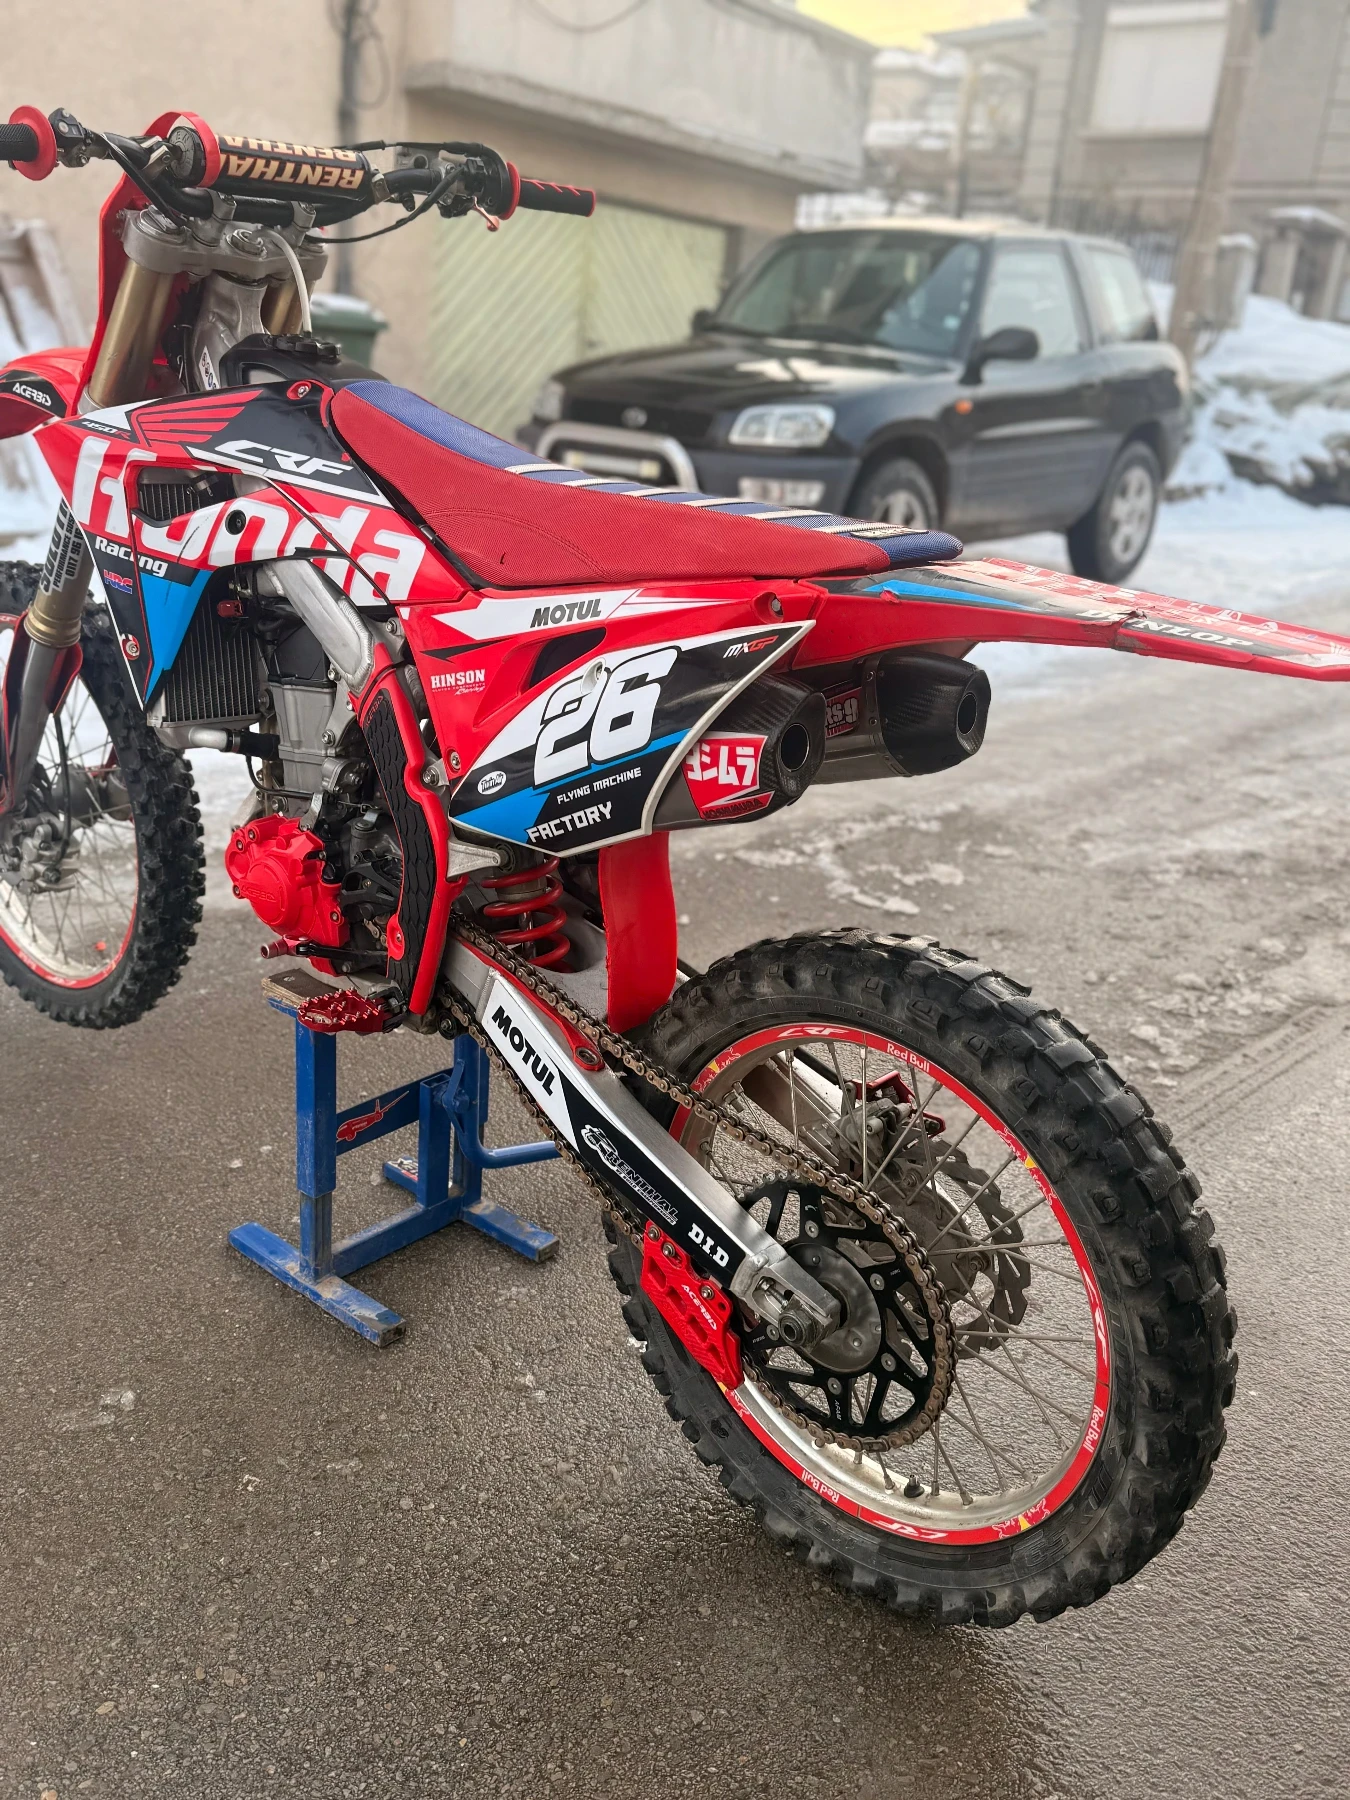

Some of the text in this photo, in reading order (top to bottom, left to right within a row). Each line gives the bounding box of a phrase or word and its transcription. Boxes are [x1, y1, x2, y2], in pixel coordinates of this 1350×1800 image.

[216, 134, 357, 162] RENTHA
[220, 152, 365, 190] RENTHA
[213, 438, 354, 476] CRF
[71, 436, 426, 607] Honda
[103, 568, 133, 595] HRC
[529, 598, 602, 629] MOTUL
[1075, 608, 1254, 648] DUNLOP
[430, 668, 486, 690] HINSON
[534, 647, 679, 786] 26
[556, 766, 642, 805] FLYING MACHINE
[525, 800, 613, 843] FACTORY
[490, 1004, 556, 1097] MOTUL
[776, 1026, 850, 1038] CRF
[886, 1042, 931, 1073] Red Bull
[605, 1149, 679, 1221] RENTHAL
[1083, 1404, 1104, 1454] Red Bull
[801, 1469, 840, 1503] Red Bull
[871, 1519, 949, 1540] CRF
